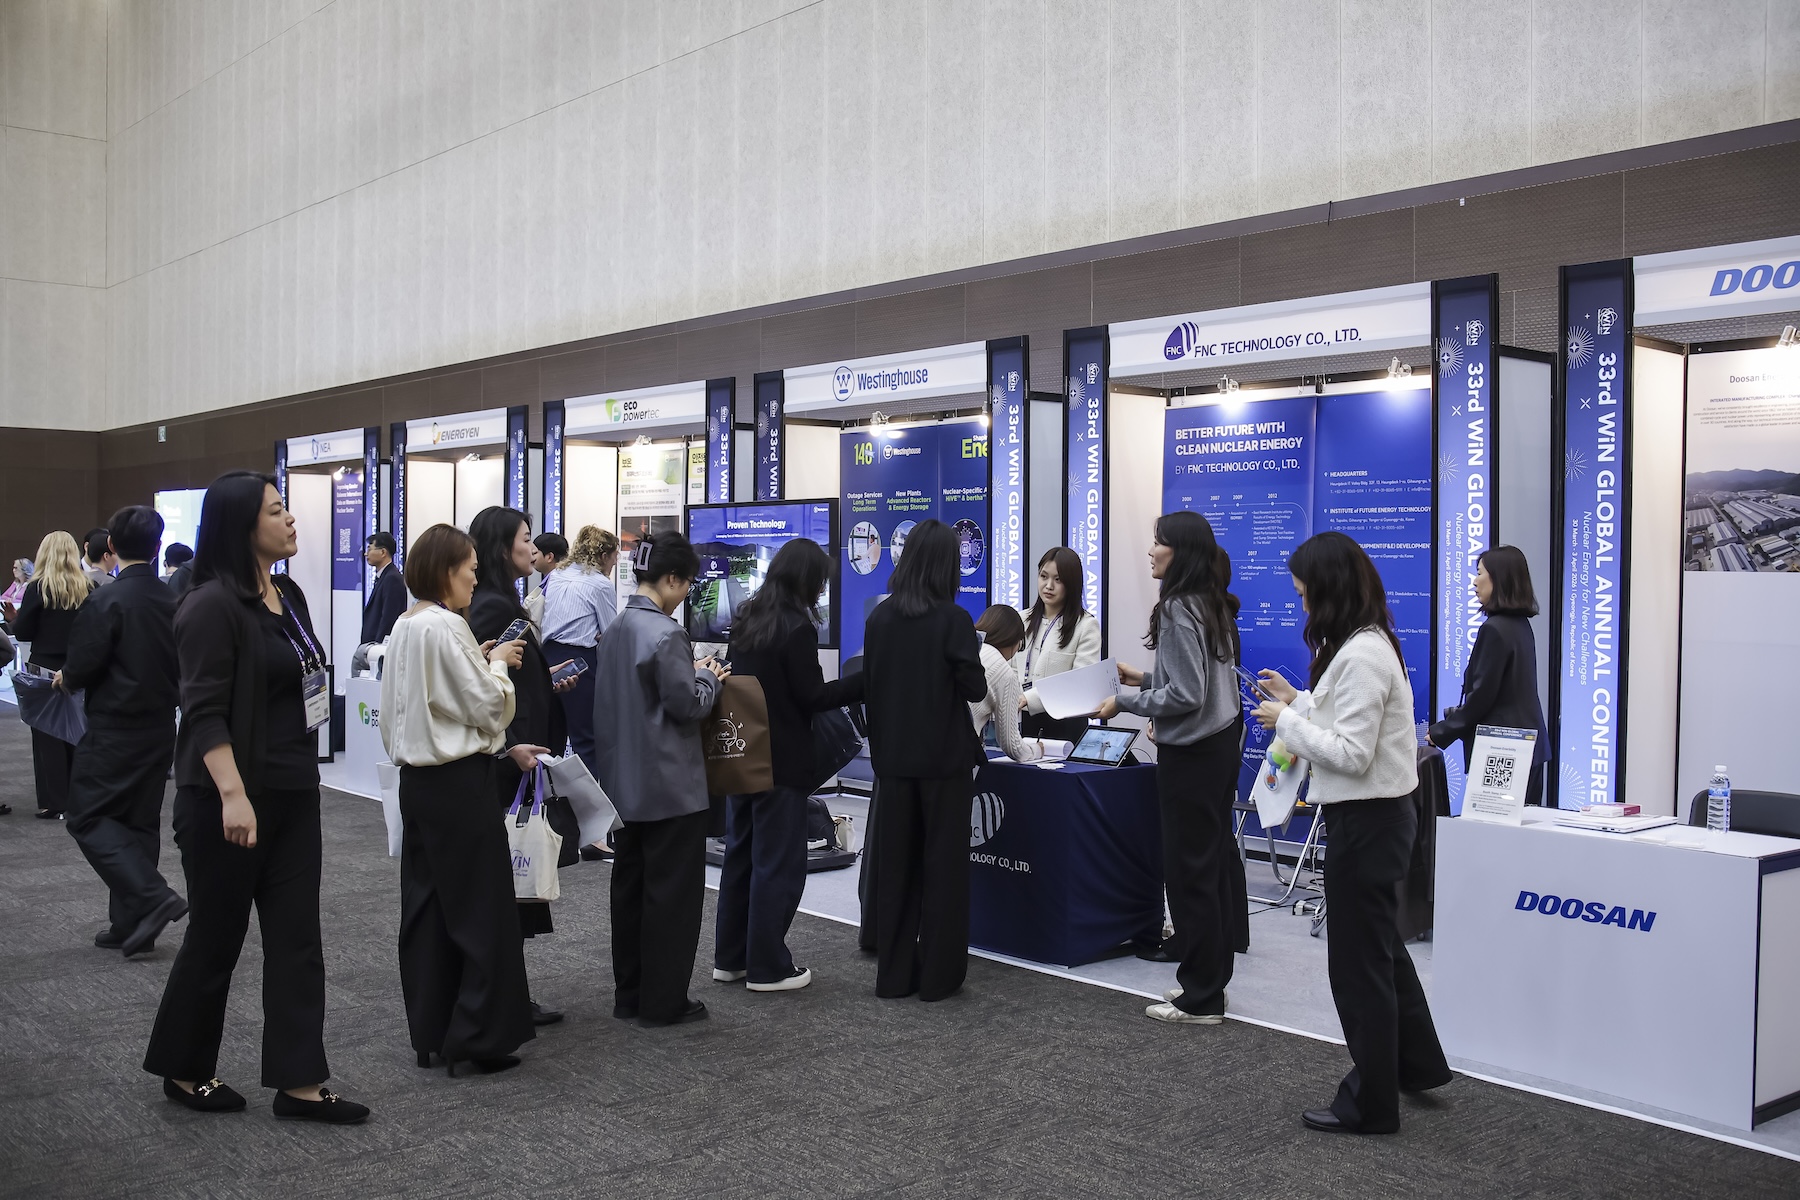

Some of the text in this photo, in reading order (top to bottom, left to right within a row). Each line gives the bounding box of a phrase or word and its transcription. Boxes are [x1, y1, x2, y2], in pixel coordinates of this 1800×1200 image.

[1166, 346, 1182, 356] FNC
[1194, 328, 1362, 358] FNC TECHNOLOGY CO., LTD.
[857, 368, 928, 391] Westinghouse
[1467, 362, 1484, 412] 33rd
[1598, 352, 1617, 405] 33rd
[1730, 375, 1760, 383] Doosan
[623, 401, 638, 411] eco
[623, 408, 660, 423] powertec
[1087, 398, 1099, 439] 33rd
[441, 426, 479, 441] ENERGYEN
[1009, 405, 1019, 444] 33rd
[1176, 421, 1285, 440] BETTER FUTURE WITH
[320, 442, 331, 453] NEA
[770, 428, 778, 462] 33rd
[893, 446, 922, 456] Westinghouse
[1176, 437, 1303, 456] CLEAN NUCLEAR ENERGY
[1176, 459, 1300, 475] BY FNC TECHNOLOGY CO., LTD.
[893, 504, 910, 512] Energy
[910, 503, 929, 511] Storage
[1467, 474, 1484, 567] GLOBAL
[1596, 469, 1616, 568] GLOBAL
[727, 519, 786, 529] Proven Technology
[1009, 491, 1019, 565] GLOBAL
[1087, 488, 1098, 566] GLOBAL
[1454, 551, 1464, 585] Energy
[1455, 586, 1464, 600] for
[1580, 511, 1592, 686] Nuclear Energy for New Challenges
[1455, 602, 1463, 625] New
[1594, 575, 1613, 681] ANNUAL
[1454, 626, 1464, 678] Challenges
[1590, 688, 1611, 803] CONFERE
[970, 852, 996, 865] OLOGY
[1015, 860, 1032, 874] LTD.
[1514, 890, 1657, 932] DOOSAN
